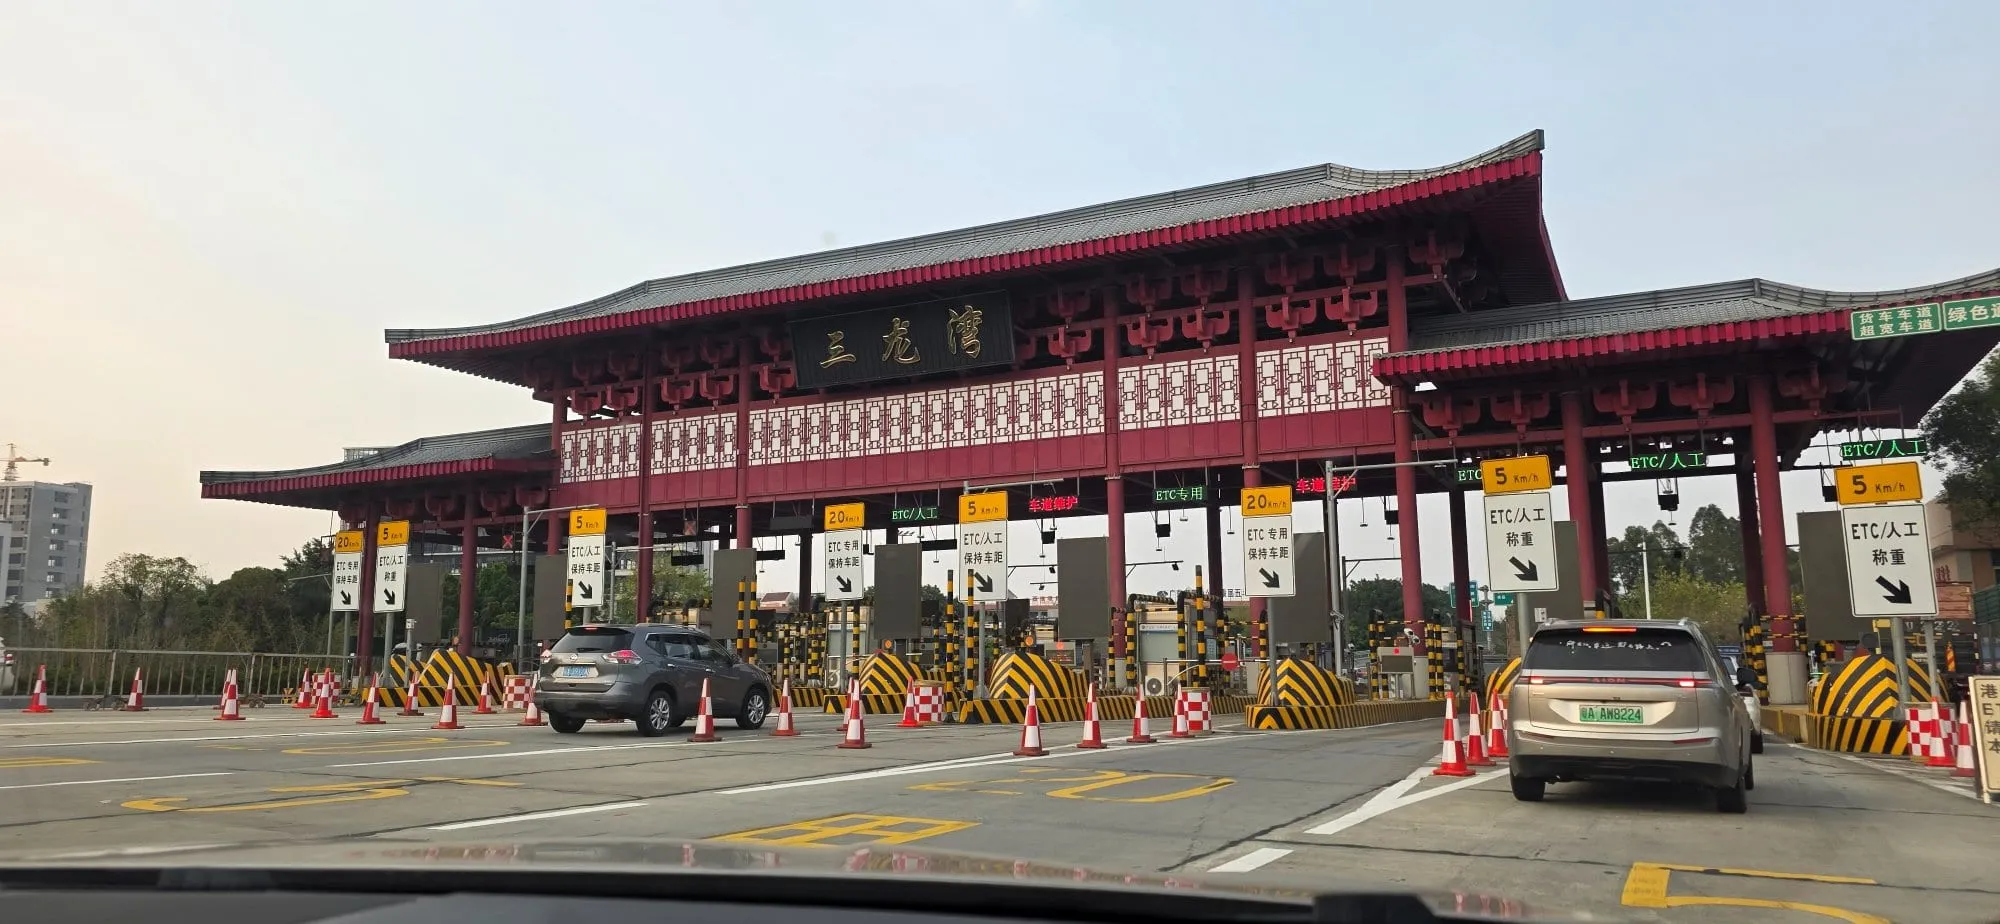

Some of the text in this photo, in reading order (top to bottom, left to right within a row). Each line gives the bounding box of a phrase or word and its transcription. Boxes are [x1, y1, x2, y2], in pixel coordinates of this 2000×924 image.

[1859, 307, 1932, 325] 货车车道
[1859, 319, 1934, 337] 超宽车道
[820, 305, 983, 369] 三龙湾
[1843, 440, 1927, 457] ETC/人工
[1631, 453, 1706, 469] ETC/人工
[1495, 467, 1507, 485] 5
[1852, 475, 1867, 495] 5
[1156, 487, 1203, 501] ETC专用
[968, 501, 977, 516] 5
[1029, 495, 1078, 512] 车道维护
[891, 507, 938, 520] ETC/人工
[1490, 508, 1546, 525] ETC/人工
[576, 515, 583, 529] 5
[383, 527, 389, 540] 5
[1247, 527, 1288, 541] ETC 专用
[1851, 522, 1920, 540] ETC/人工
[828, 540, 859, 552] ETC 专用
[964, 532, 1003, 546] ETC/人工
[1506, 531, 1534, 547] 称重
[571, 545, 600, 558] ETC/人工
[964, 551, 1003, 565] 保持车距
[1248, 546, 1289, 560] 保持车距
[1872, 549, 1907, 566] 称重
[379, 555, 404, 567] ETC/人工
[571, 562, 600, 574] 保持车距
[828, 556, 860, 569] 保持车距
[384, 571, 397, 582] 称重
